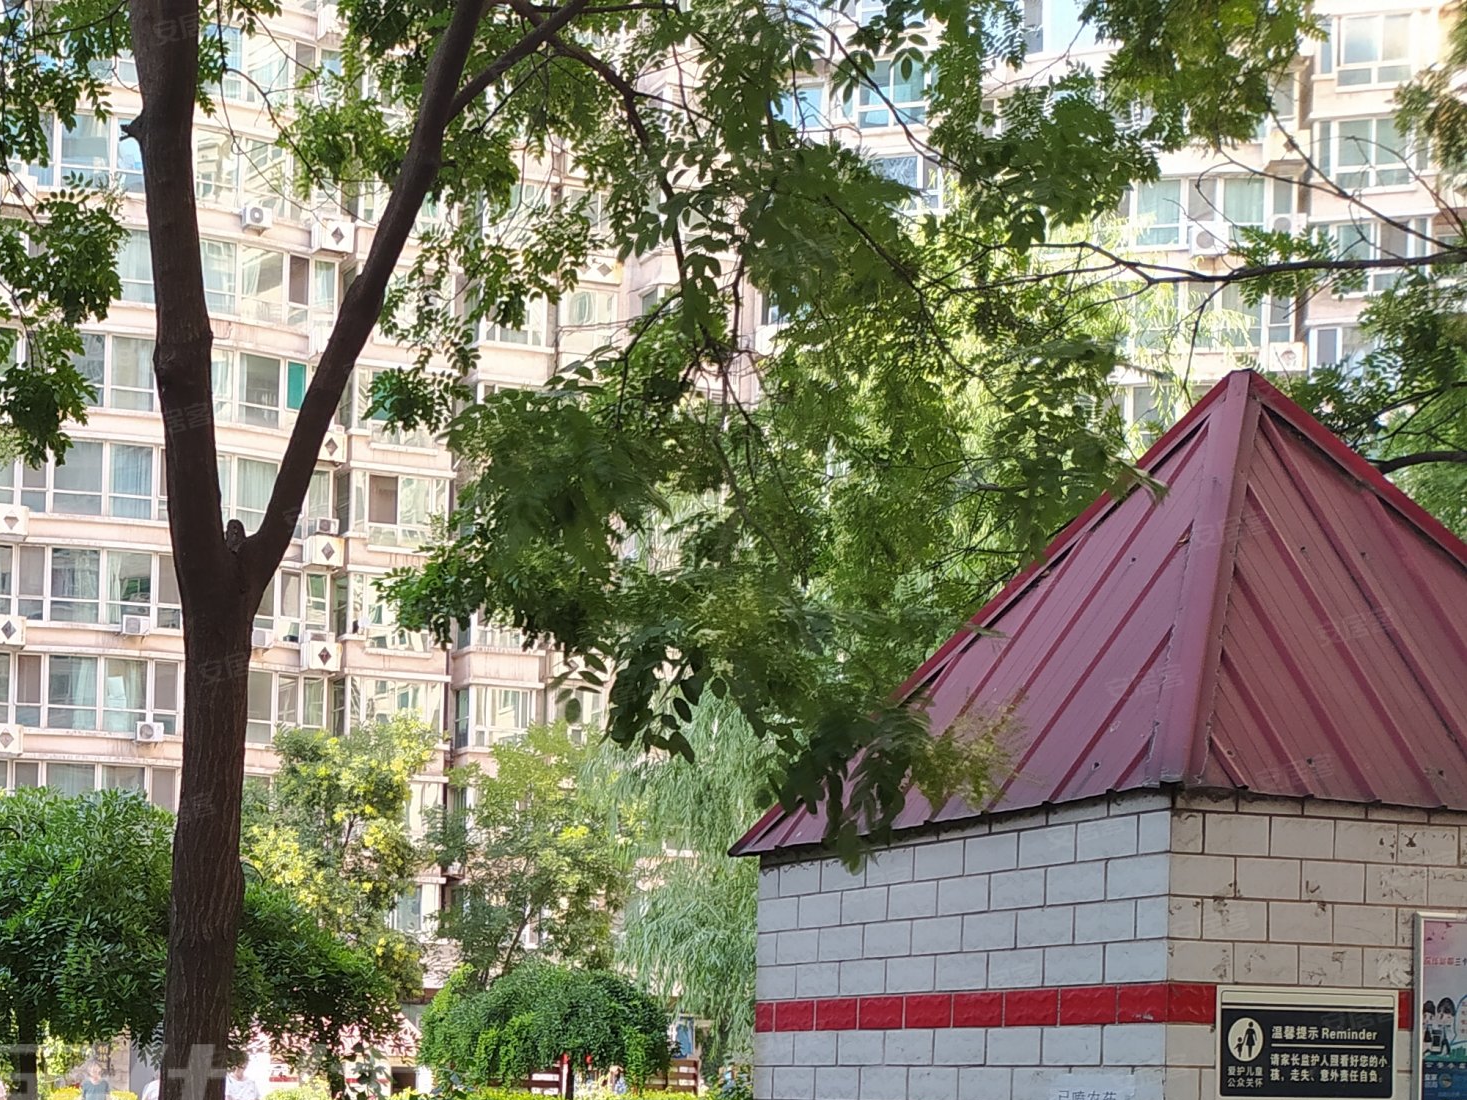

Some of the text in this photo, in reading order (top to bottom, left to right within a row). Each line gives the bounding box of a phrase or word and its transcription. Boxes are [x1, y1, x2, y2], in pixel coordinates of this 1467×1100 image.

[1271, 1025, 1377, 1041] 温馨提示 Reminder
[1270, 1053, 1388, 1067] 请家长监护人照看好您的小
[1227, 1066, 1264, 1077] 爱护儿童
[1227, 1077, 1264, 1088] 公众关怀
